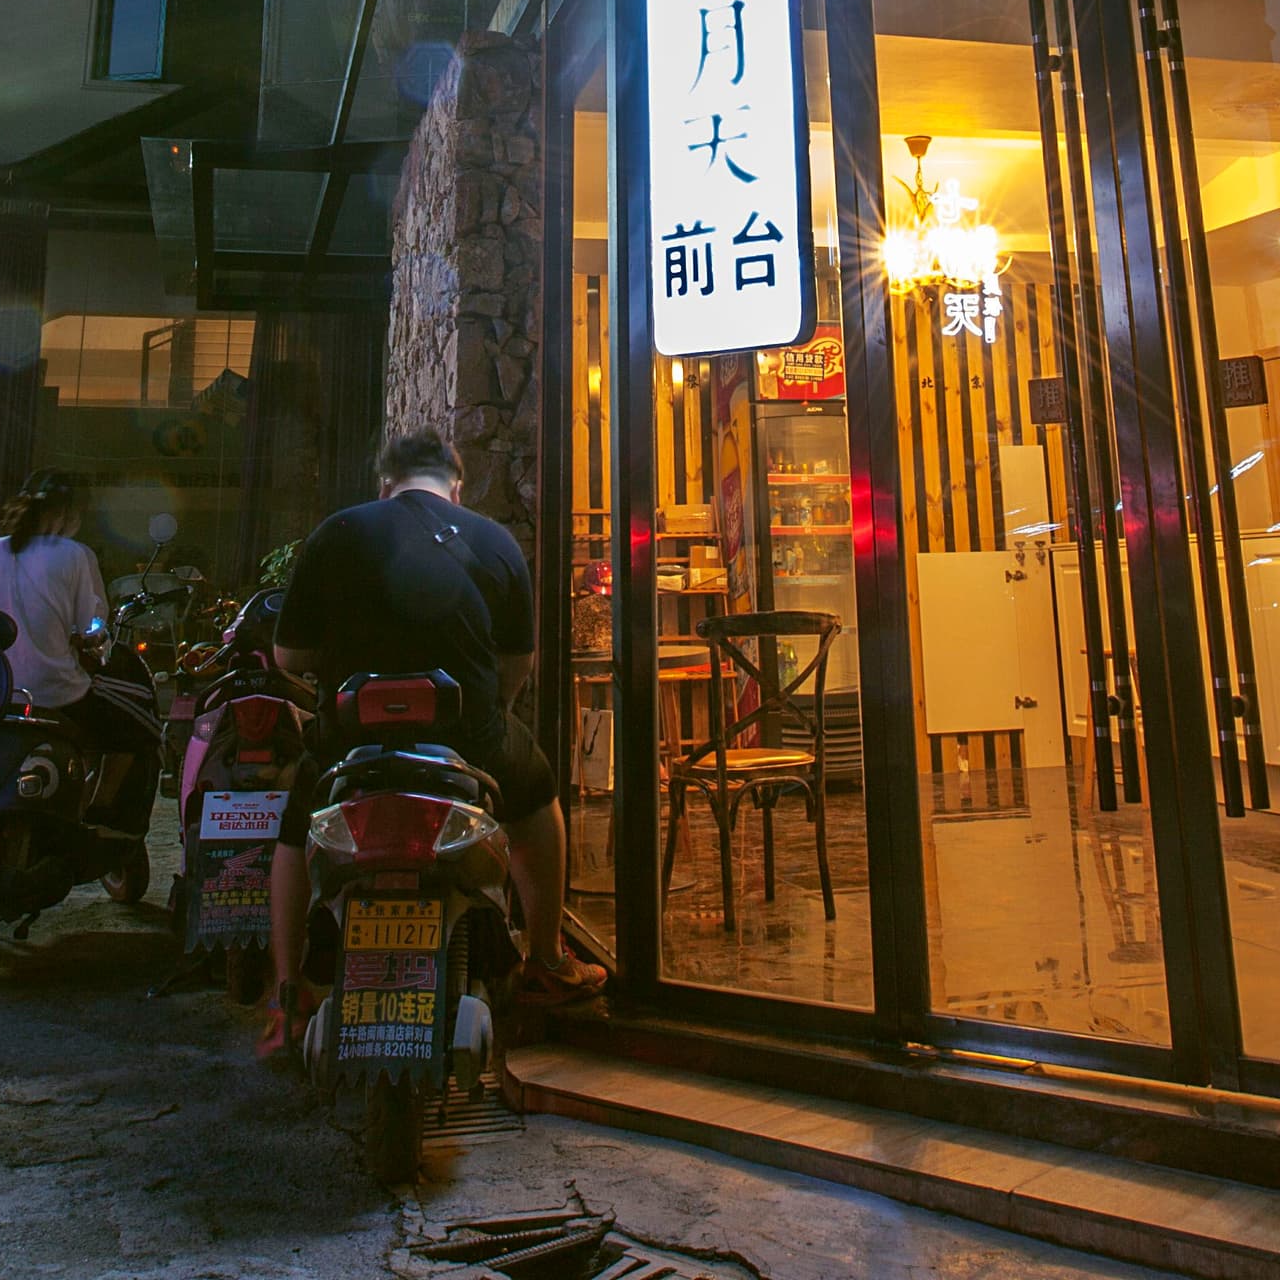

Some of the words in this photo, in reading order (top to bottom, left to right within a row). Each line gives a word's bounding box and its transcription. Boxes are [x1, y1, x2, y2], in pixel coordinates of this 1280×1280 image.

[660, 209, 785, 299] 前台
[1224, 361, 1250, 389] 推
[373, 923, 438, 945] 111217
[341, 991, 436, 1024] 销量10连冠
